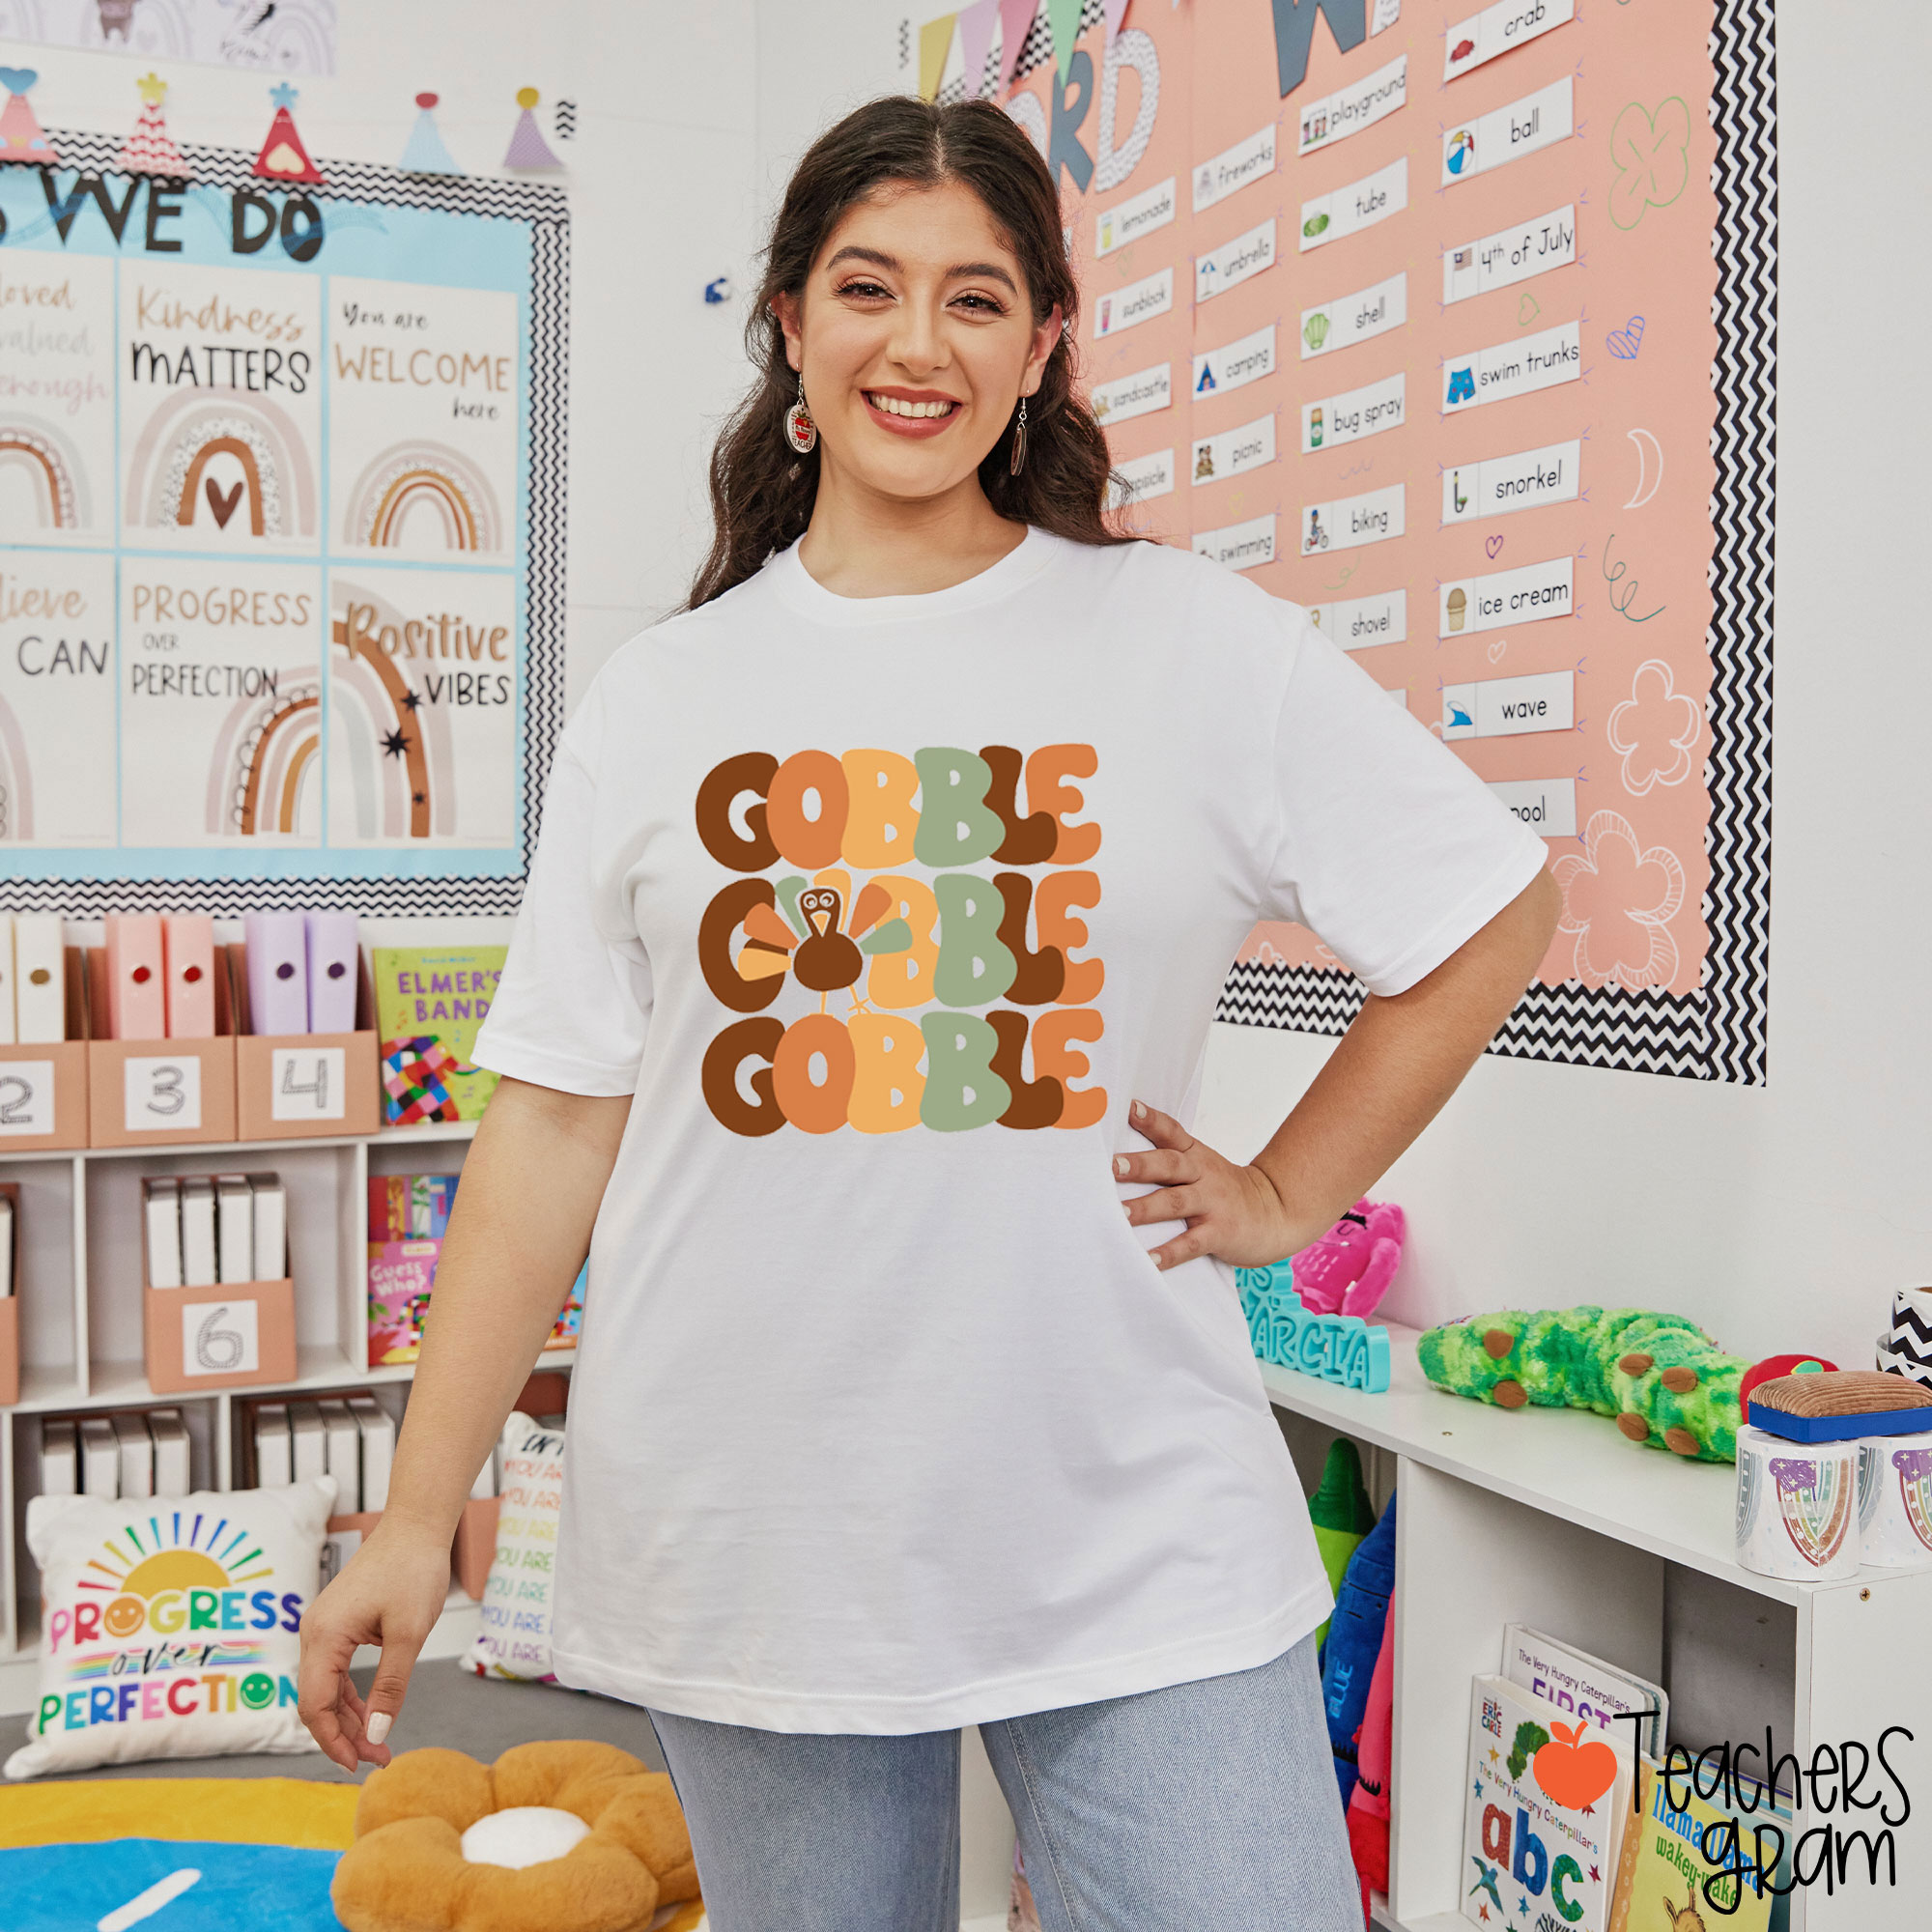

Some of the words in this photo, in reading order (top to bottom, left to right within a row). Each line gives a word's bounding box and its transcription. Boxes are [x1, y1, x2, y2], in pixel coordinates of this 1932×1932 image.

[1504, 0, 1546, 36] crab
[1331, 65, 1406, 131] playground
[1510, 106, 1540, 144] ball
[1218, 141, 1273, 189] fireworks
[39, 168, 187, 253] WE
[232, 190, 325, 263] DO
[1122, 192, 1171, 233] lemonade
[1356, 188, 1386, 216] tube
[1225, 238, 1270, 277] umbrella
[1511, 235, 1531, 266] of
[1538, 222, 1574, 255] July
[136, 283, 307, 343] Kindness
[343, 301, 385, 327] You
[394, 313, 428, 330] are
[1122, 281, 1166, 319] sunblock
[1355, 296, 1385, 329] shell
[335, 342, 511, 392] WELCOME
[1226, 349, 1269, 379] camping
[1479, 362, 1521, 386] swim
[1525, 340, 1580, 370] trunks
[452, 397, 500, 420] here
[1113, 374, 1169, 408] sandcastle
[1334, 409, 1360, 434] bug
[1364, 397, 1403, 427] spray
[1232, 440, 1263, 469] picnic
[1495, 459, 1563, 499] snorkel
[1351, 507, 1388, 533] biking
[1219, 534, 1272, 563] swimming
[132, 582, 312, 626] PROGRESS
[1478, 596, 1503, 617] ice
[1510, 583, 1569, 610] cream
[346, 601, 509, 662] Positive
[1351, 606, 1391, 638] shovel
[17, 635, 109, 676] CAN
[143, 632, 180, 652] OVER
[131, 662, 279, 698] PERFECTION
[425, 672, 511, 706] VIBES
[1501, 700, 1548, 720] wave
[696, 743, 1102, 873] GOBBLE
[697, 870, 1106, 1014] GBBLE
[397, 969, 502, 995] ELMER'S
[414, 999, 493, 1023] BAND
[145, 1064, 186, 1117] 3
[280, 1057, 329, 1111] 4
[701, 1008, 1108, 1138] GOBBLE
[0, 1075, 34, 1124] 2
[370, 1260, 423, 1283] Guess
[375, 1273, 428, 1298] Who?
[196, 1305, 244, 1370] 6
[1240, 1297, 1371, 1388] ARCIA
[50, 1589, 303, 1655] PROGRESS
[111, 1640, 224, 1676] over
[1327, 1656, 1353, 1719] BLUE
[1518, 1648, 1532, 1666] The
[1533, 1656, 1550, 1677] Very
[1550, 1665, 1579, 1693] Hungry
[1580, 1680, 1631, 1715] Caterpillar's
[38, 1672, 299, 1736] PERFECTION
[1482, 1700, 1503, 1725] ERIC
[1481, 1714, 1503, 1739] CARLE
[1479, 1760, 1492, 1780] The
[1493, 1772, 1512, 1798] Very
[1513, 1786, 1543, 1820] Hungry
[1544, 1808, 1598, 1856] Caterpillar's
[1652, 1783, 1704, 1852] llama
[1482, 1803, 1585, 1923] abc
